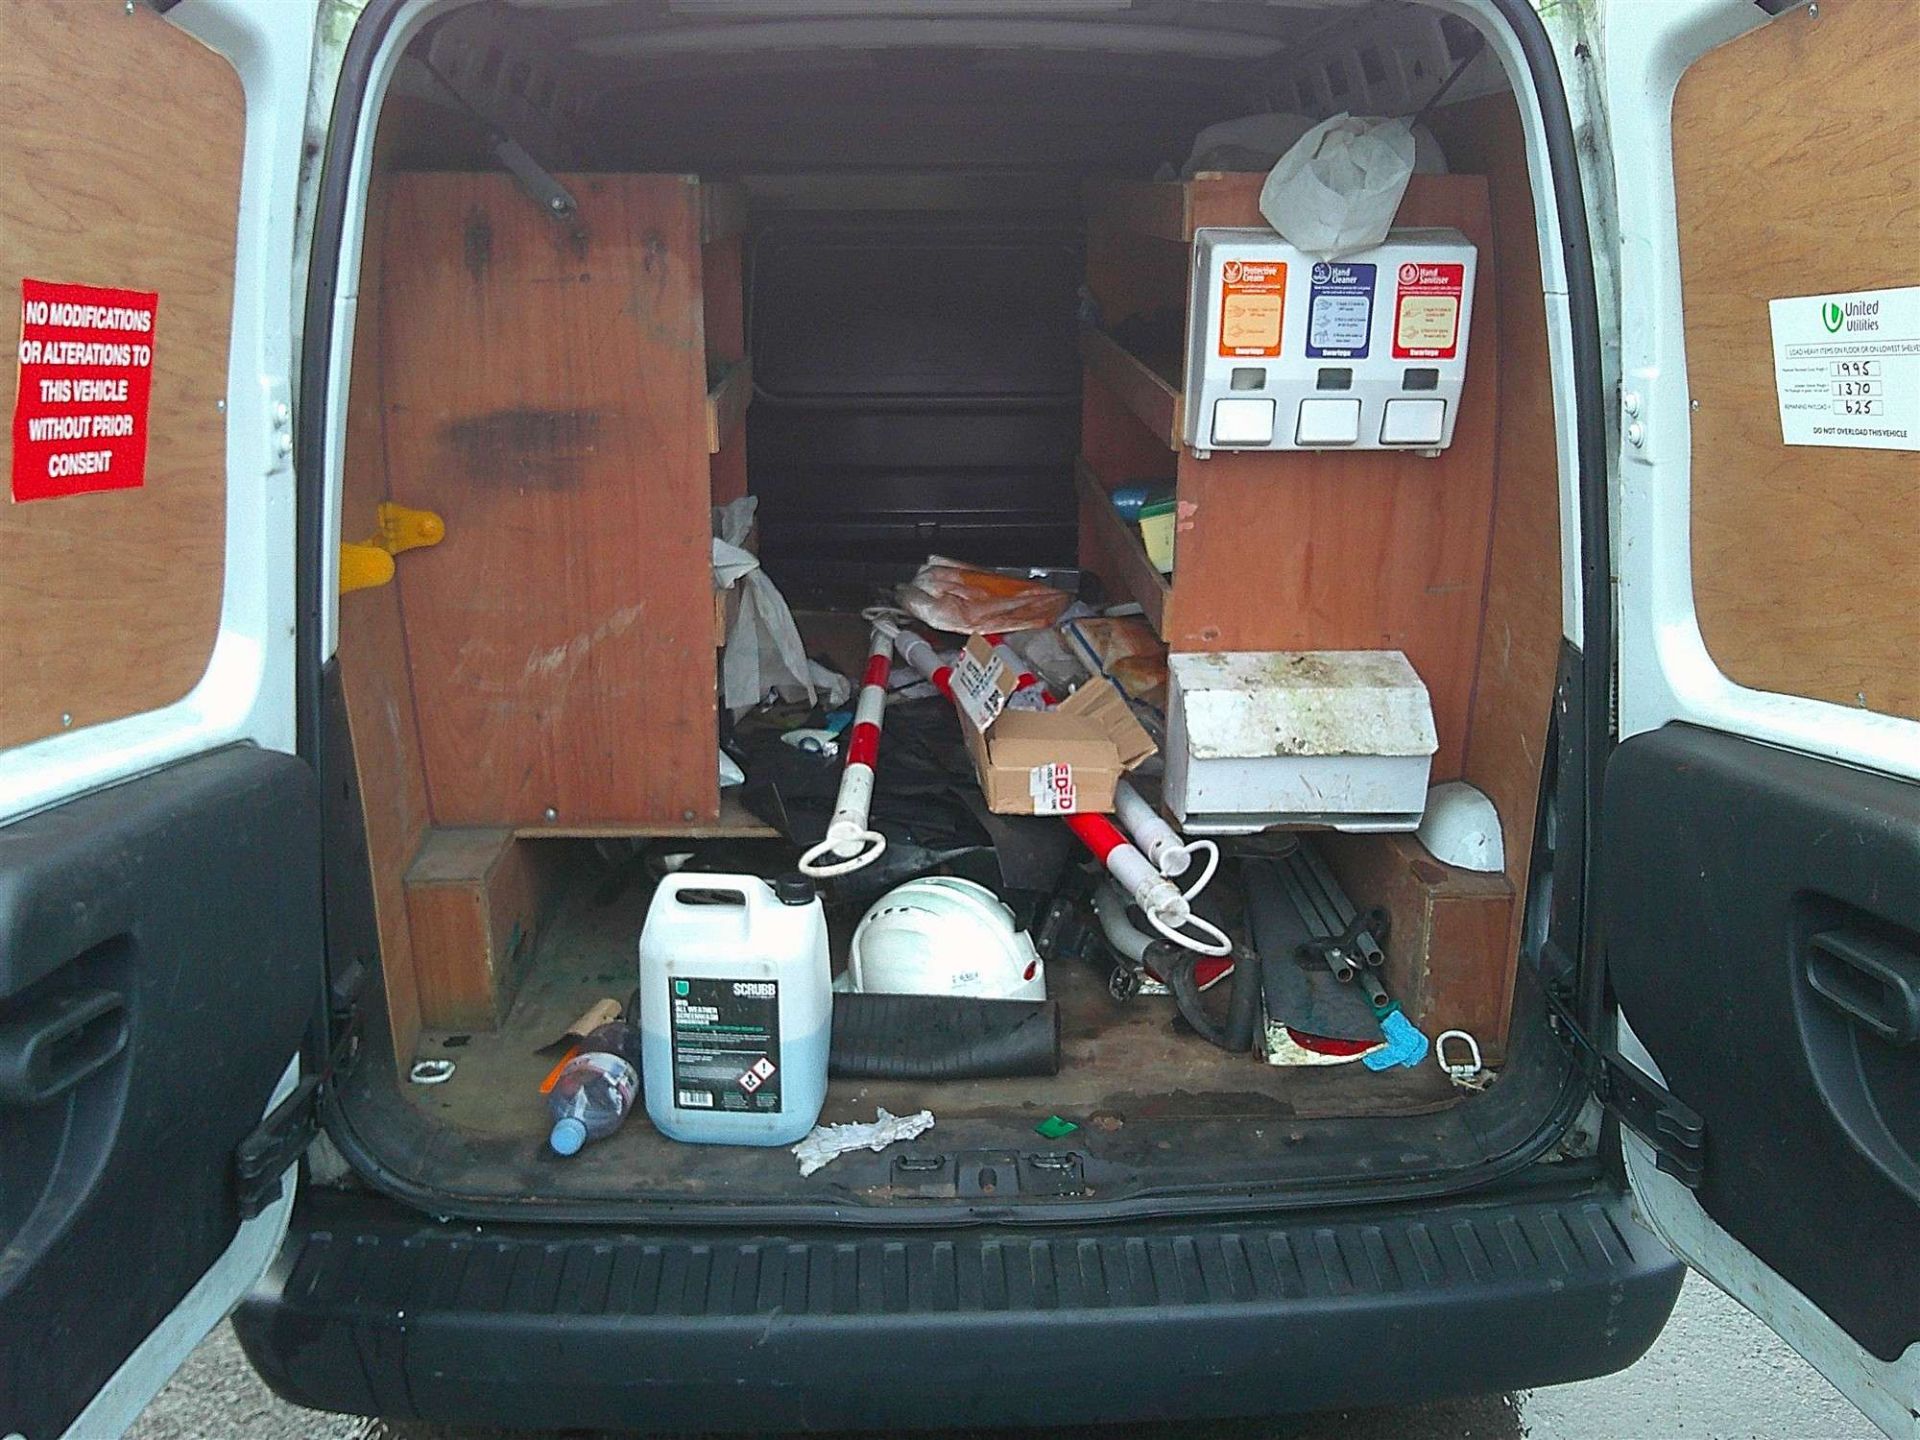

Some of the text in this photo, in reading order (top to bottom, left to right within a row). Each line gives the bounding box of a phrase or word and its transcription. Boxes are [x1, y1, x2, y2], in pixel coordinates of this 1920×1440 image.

[1332, 267, 1351, 276] Hand
[1420, 268, 1439, 276] Hand
[1331, 276, 1357, 284] Cleaner
[1419, 276, 1449, 285] Sanitiser
[1845, 300, 1879, 317] United
[26, 301, 151, 332] NO MODIFICATIONS
[1846, 319, 1879, 332] Utilities
[19, 340, 151, 367] OR ALTERATIONS TO
[1879, 345, 1900, 353] LOWEST
[1837, 361, 1870, 376] 1995
[40, 379, 128, 402] THIS VEHICLE
[1838, 381, 1870, 396] 1370
[1845, 400, 1872, 415] 625
[28, 414, 133, 441] WITHOUT PRIOR
[1837, 428, 1868, 436] OVERLOAD
[1868, 428, 1880, 436] THIS
[1880, 429, 1908, 438] VEHICLE
[48, 450, 112, 477] CONSENT
[733, 983, 776, 996] SCRUBB
